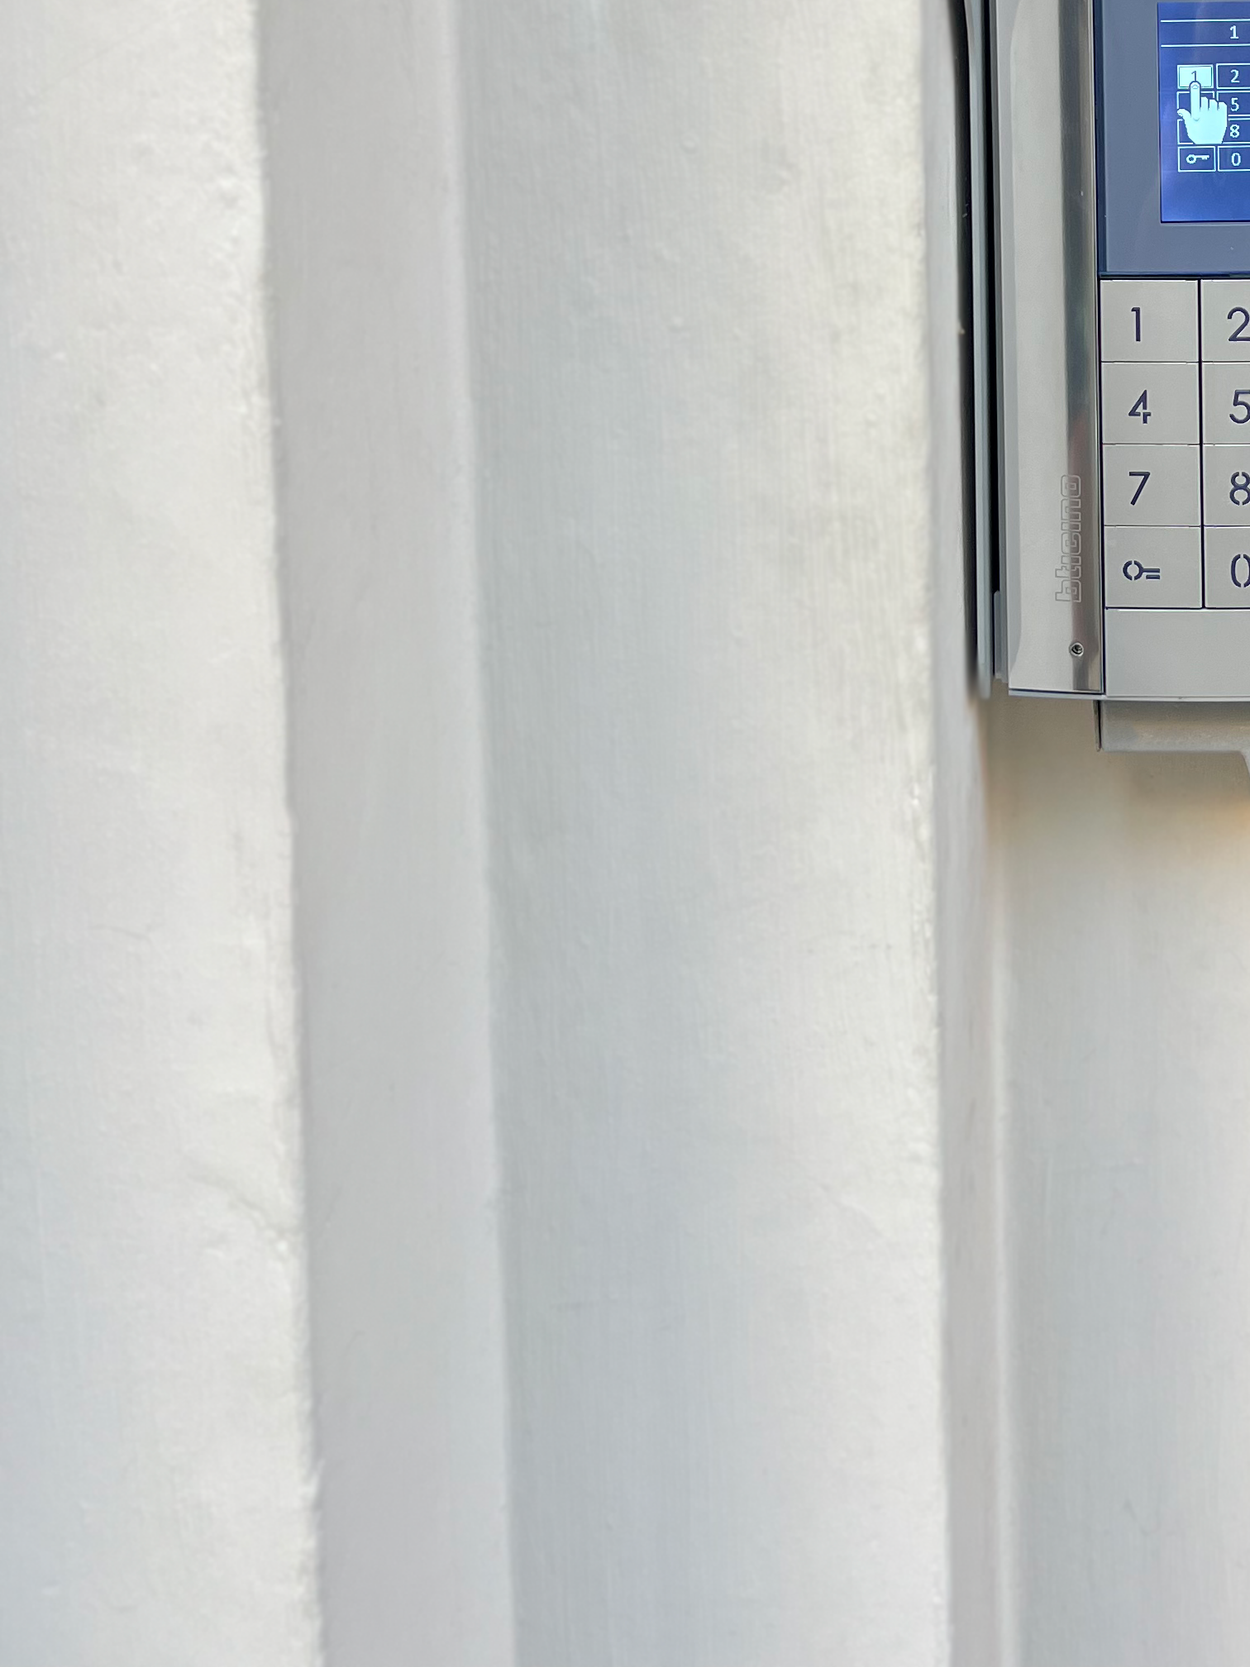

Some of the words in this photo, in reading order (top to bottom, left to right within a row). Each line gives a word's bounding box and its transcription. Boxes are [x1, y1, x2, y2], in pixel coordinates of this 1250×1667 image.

[1229, 25, 1240, 39] 1
[1230, 69, 1240, 83] 2
[1230, 97, 1240, 112] 5
[1229, 124, 1240, 139] 8
[1130, 306, 1141, 342] 1
[1227, 306, 1250, 342] 2
[1128, 389, 1152, 424] 4
[1128, 471, 1151, 506] 7
